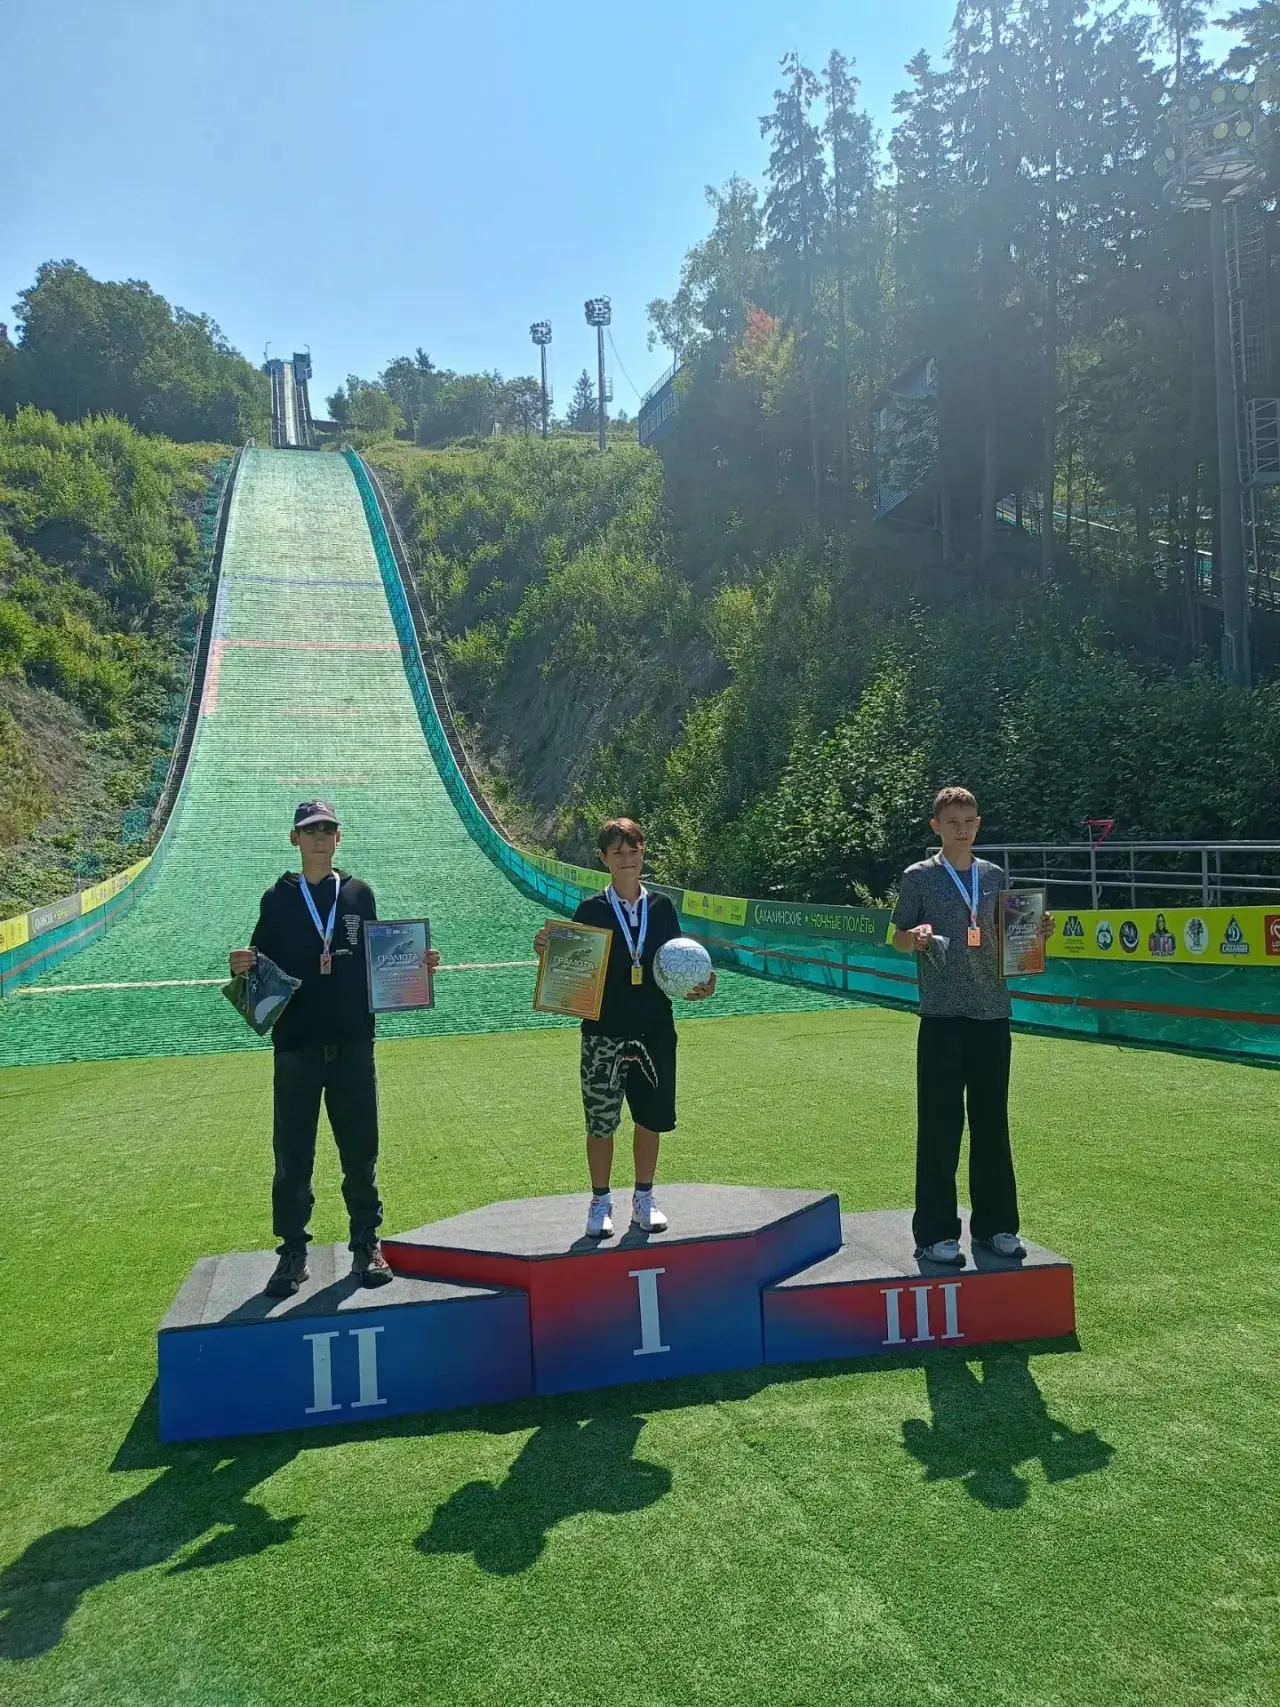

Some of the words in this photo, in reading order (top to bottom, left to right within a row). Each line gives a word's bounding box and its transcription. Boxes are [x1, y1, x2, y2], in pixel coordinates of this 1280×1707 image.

[754, 904, 802, 926] САХАЛИНСКИЕ
[842, 915, 875, 934] ПОЛЁТЫ
[377, 952, 420, 962] ГРАМОТА
[553, 956, 595, 969] ГРАМОТА
[628, 1266, 672, 1356] I
[880, 1282, 964, 1344] III
[302, 1325, 387, 1414] II
